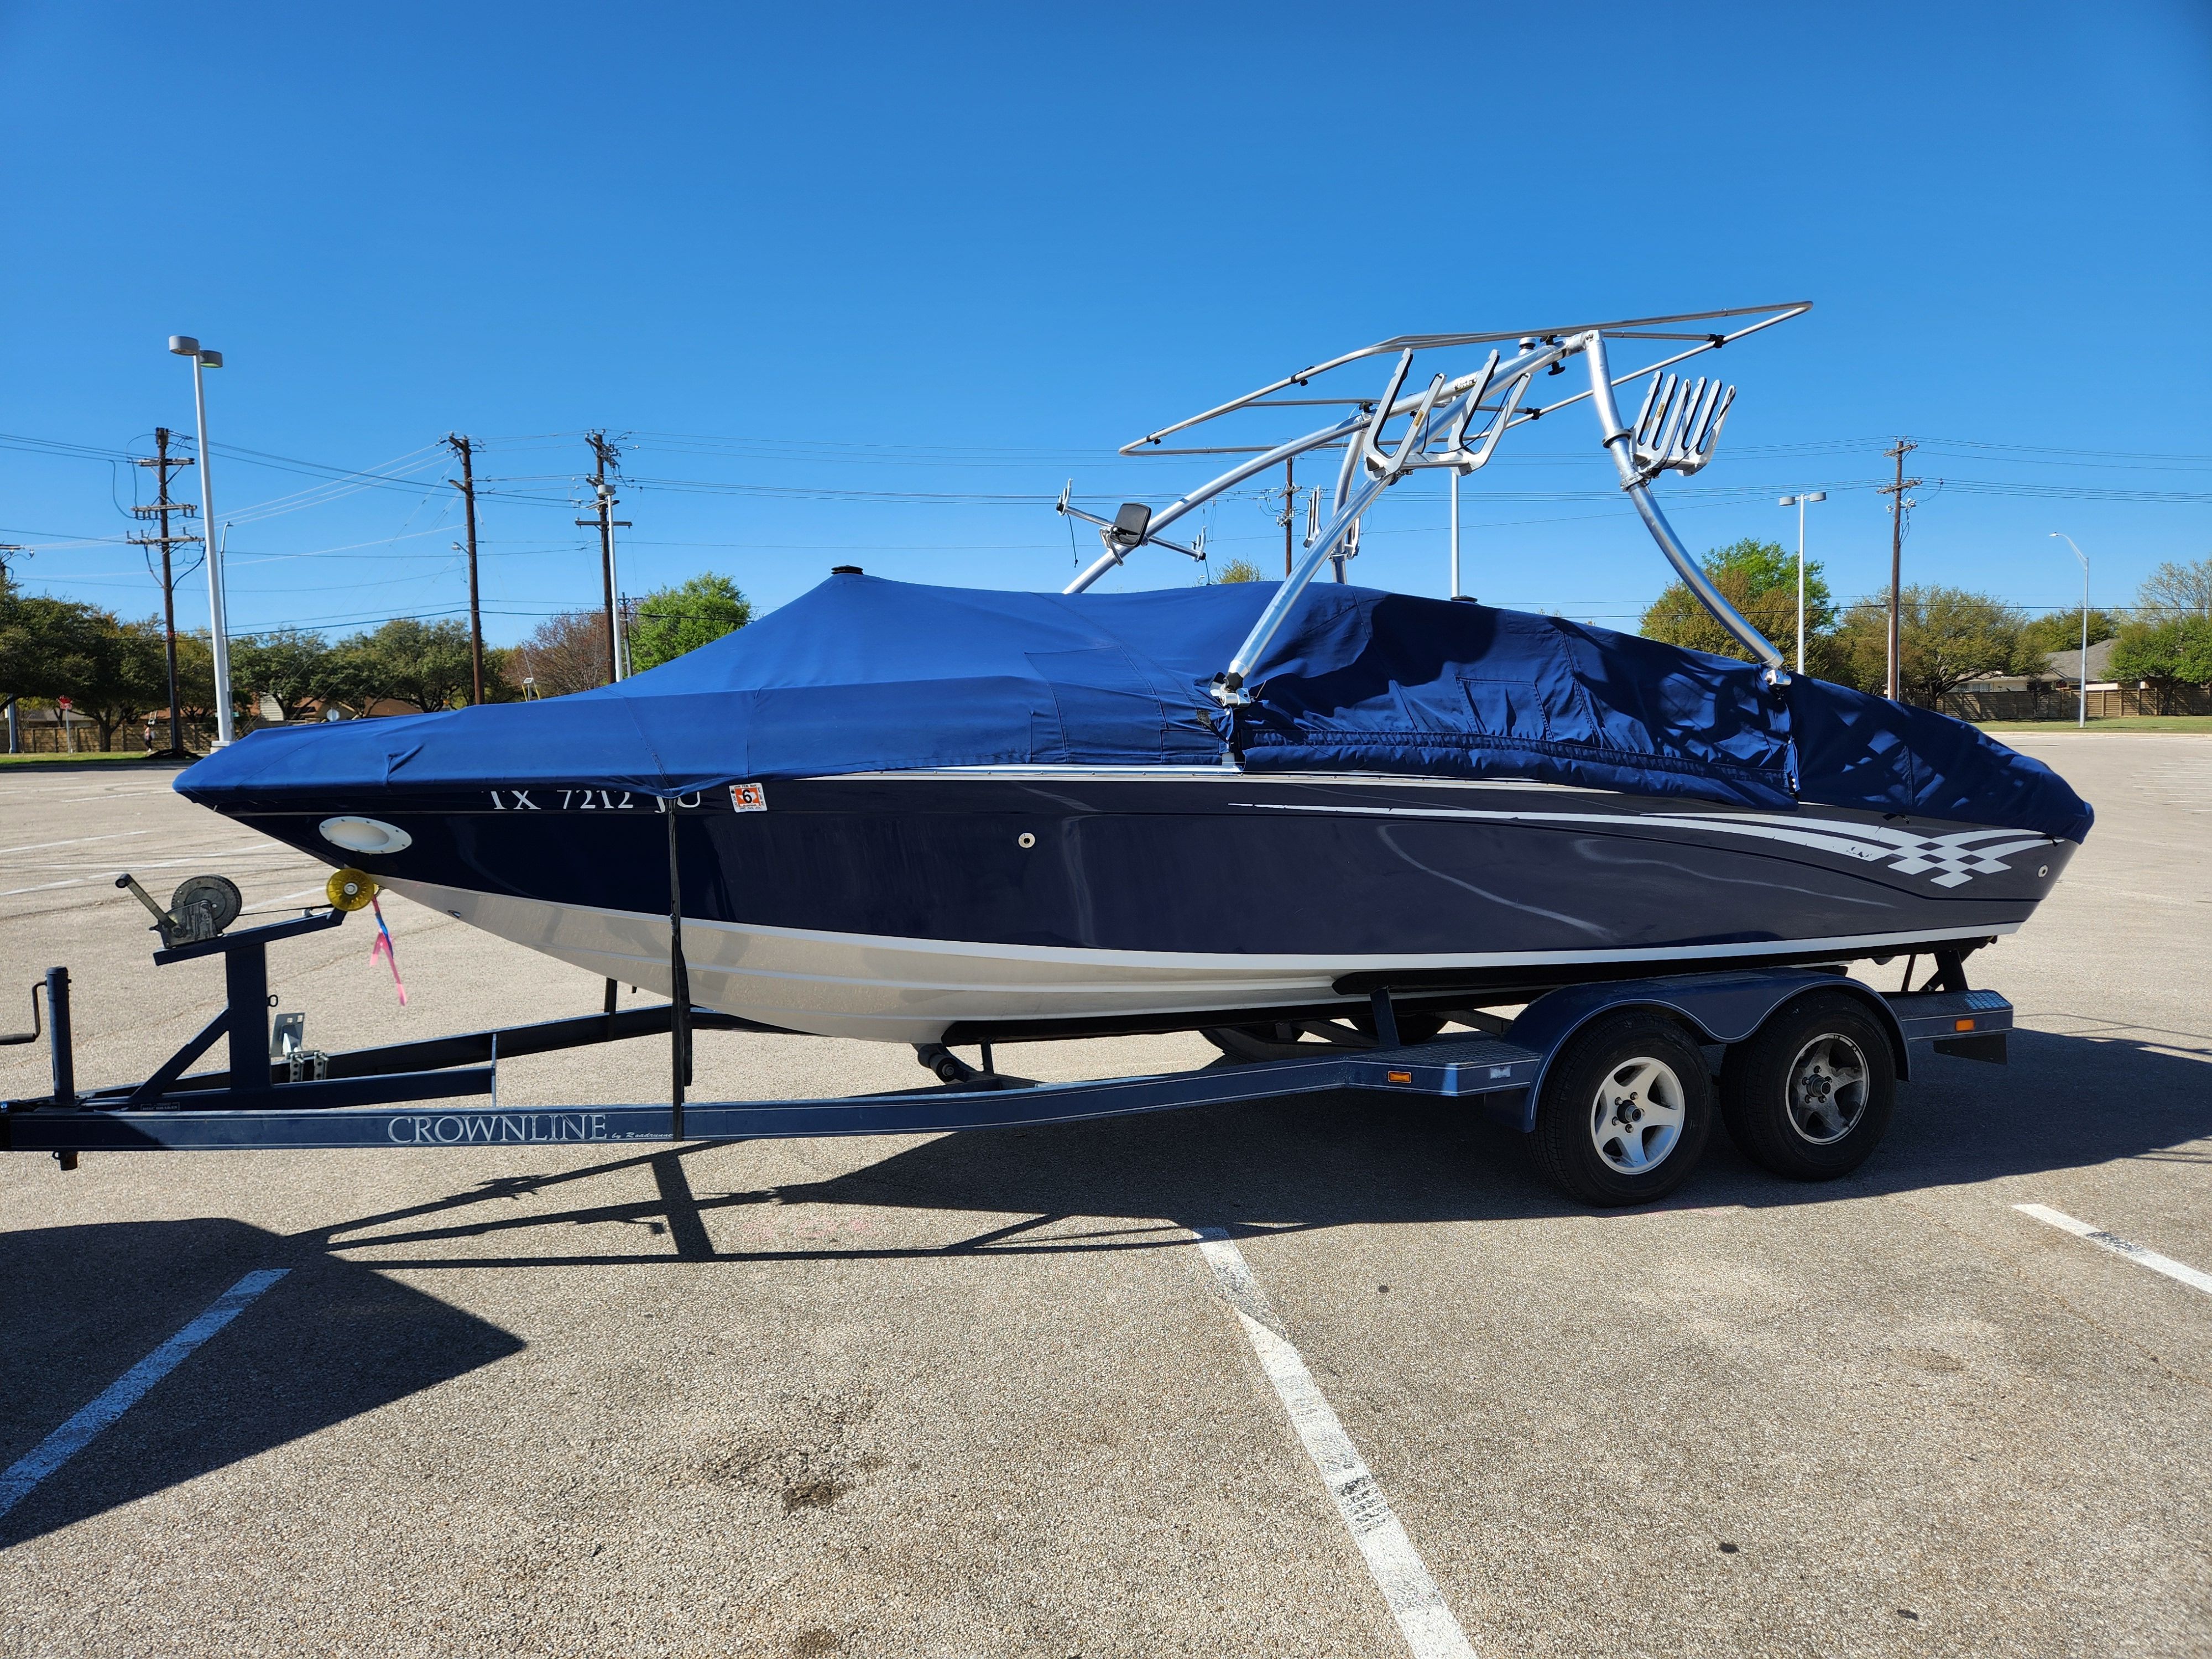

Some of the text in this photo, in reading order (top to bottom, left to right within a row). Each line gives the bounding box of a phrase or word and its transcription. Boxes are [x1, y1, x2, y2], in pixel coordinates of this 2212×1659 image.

[556, 790, 634, 809] 7212
[742, 789, 752, 804] 6
[387, 1114, 607, 1142] CROWNLINE
